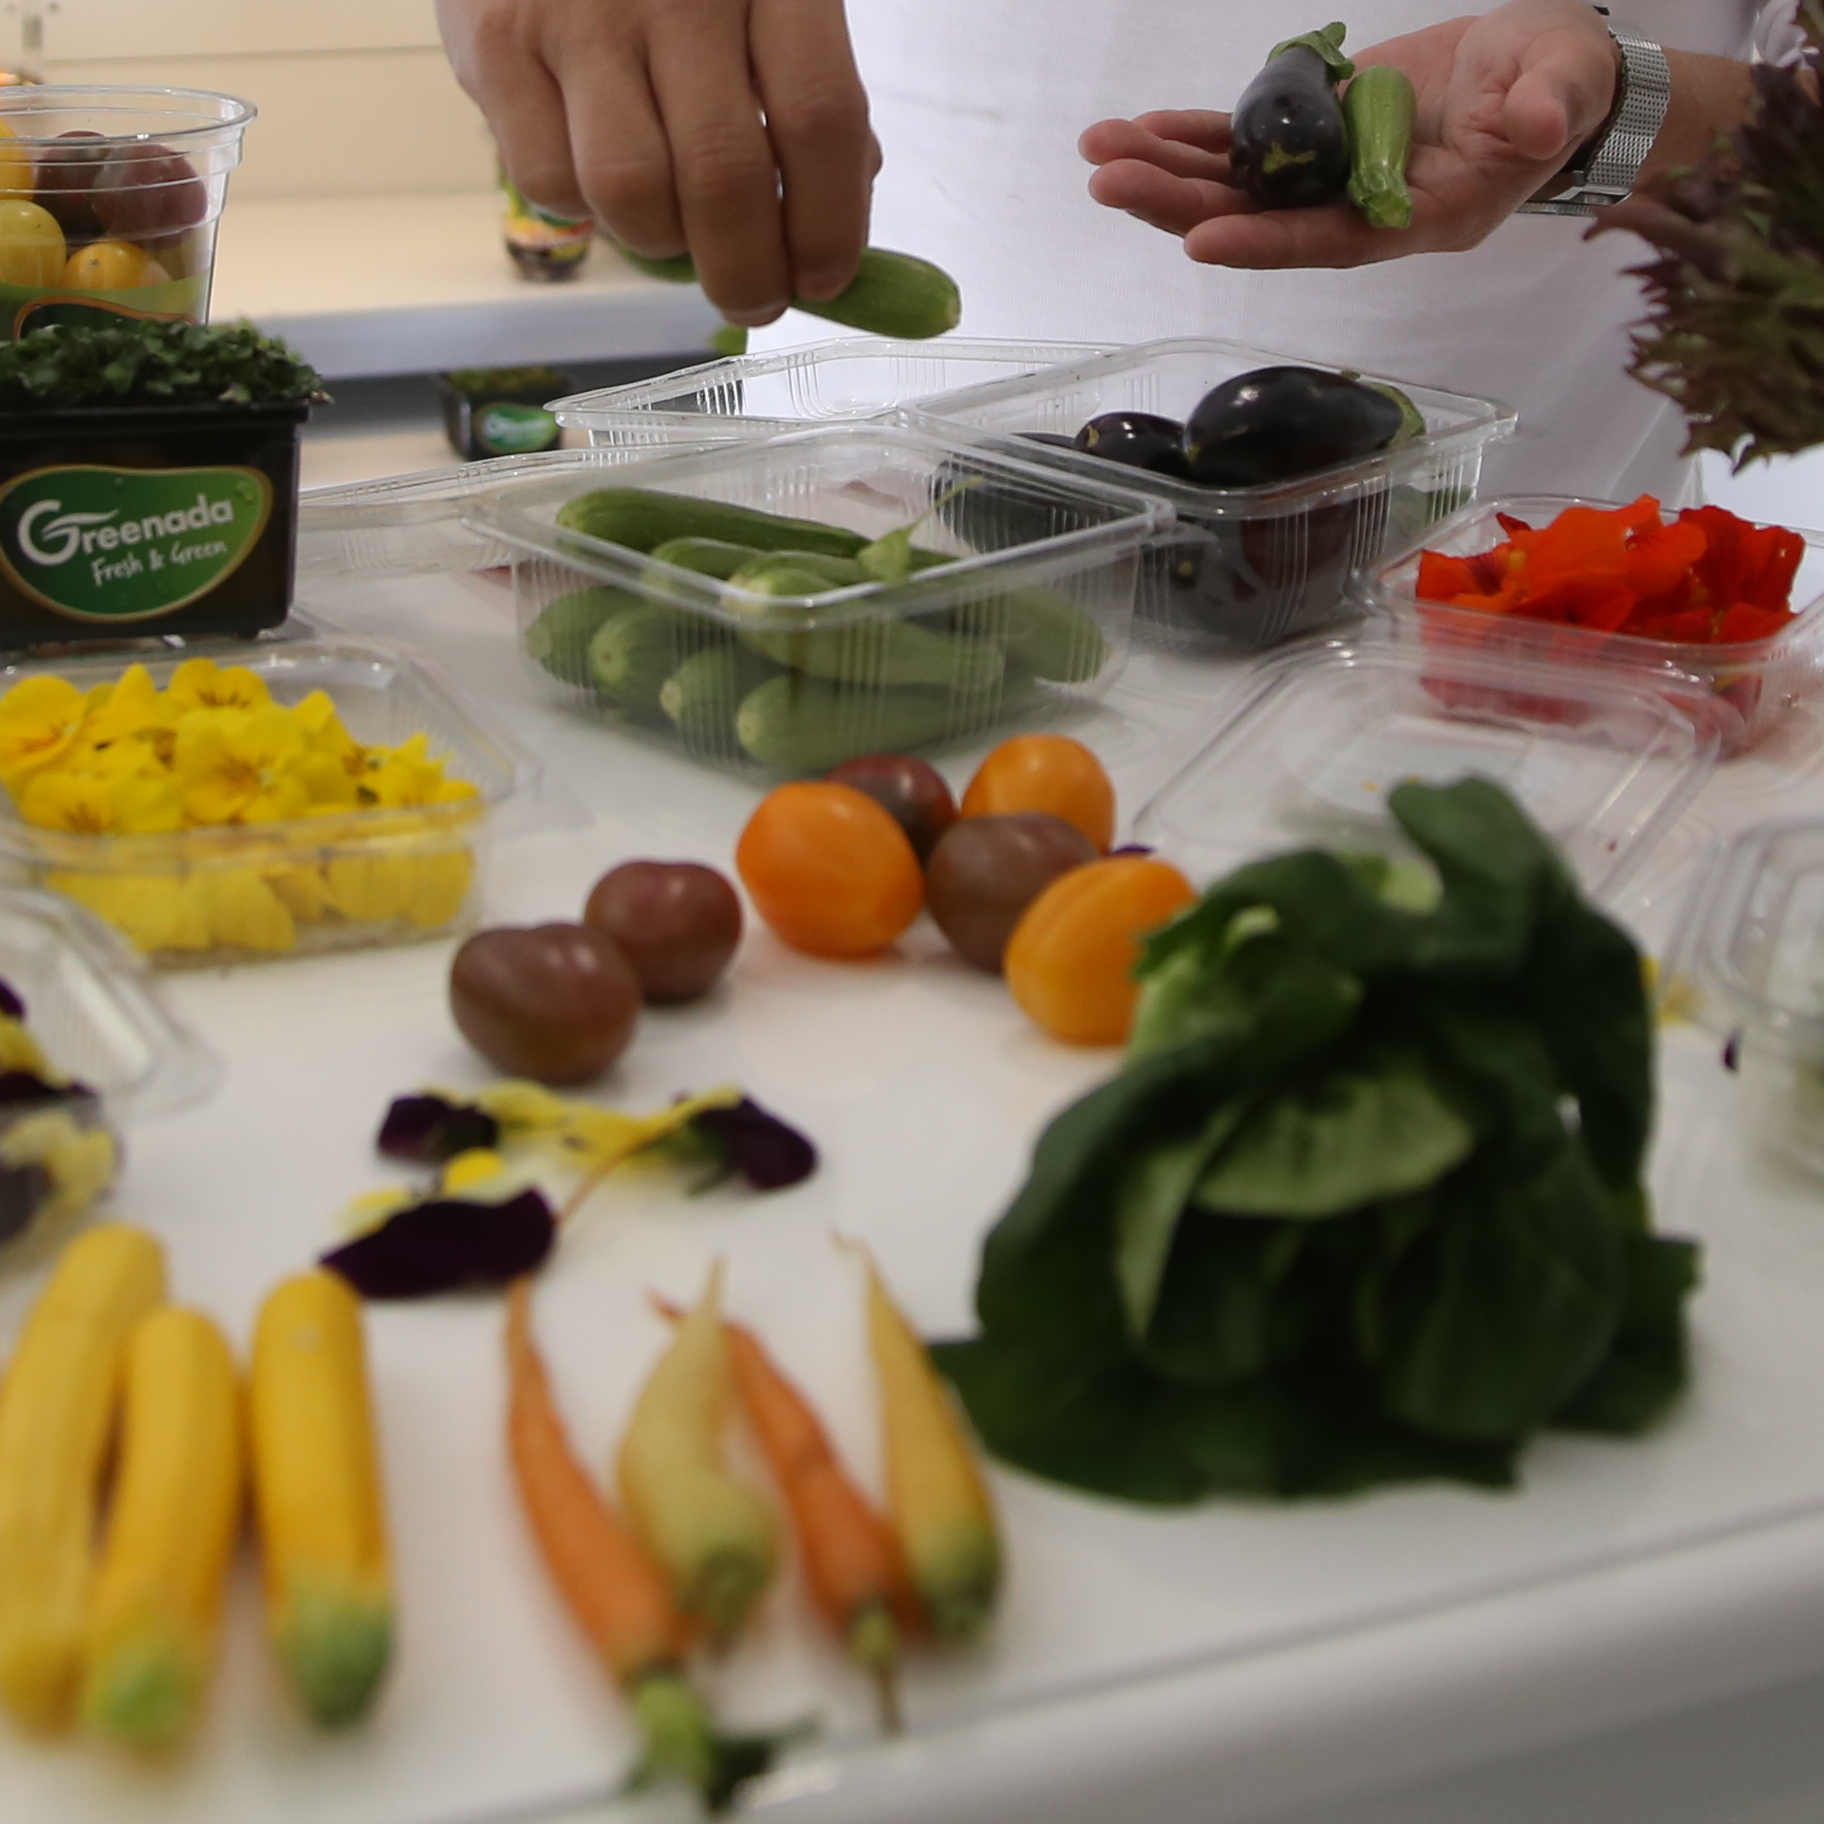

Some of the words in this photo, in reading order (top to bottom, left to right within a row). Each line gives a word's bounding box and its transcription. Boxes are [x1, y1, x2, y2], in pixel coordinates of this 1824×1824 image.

[17, 492, 235, 567] Greenada
[91, 551, 144, 587] Fresh
[149, 548, 164, 571] &
[169, 540, 229, 566] Green
